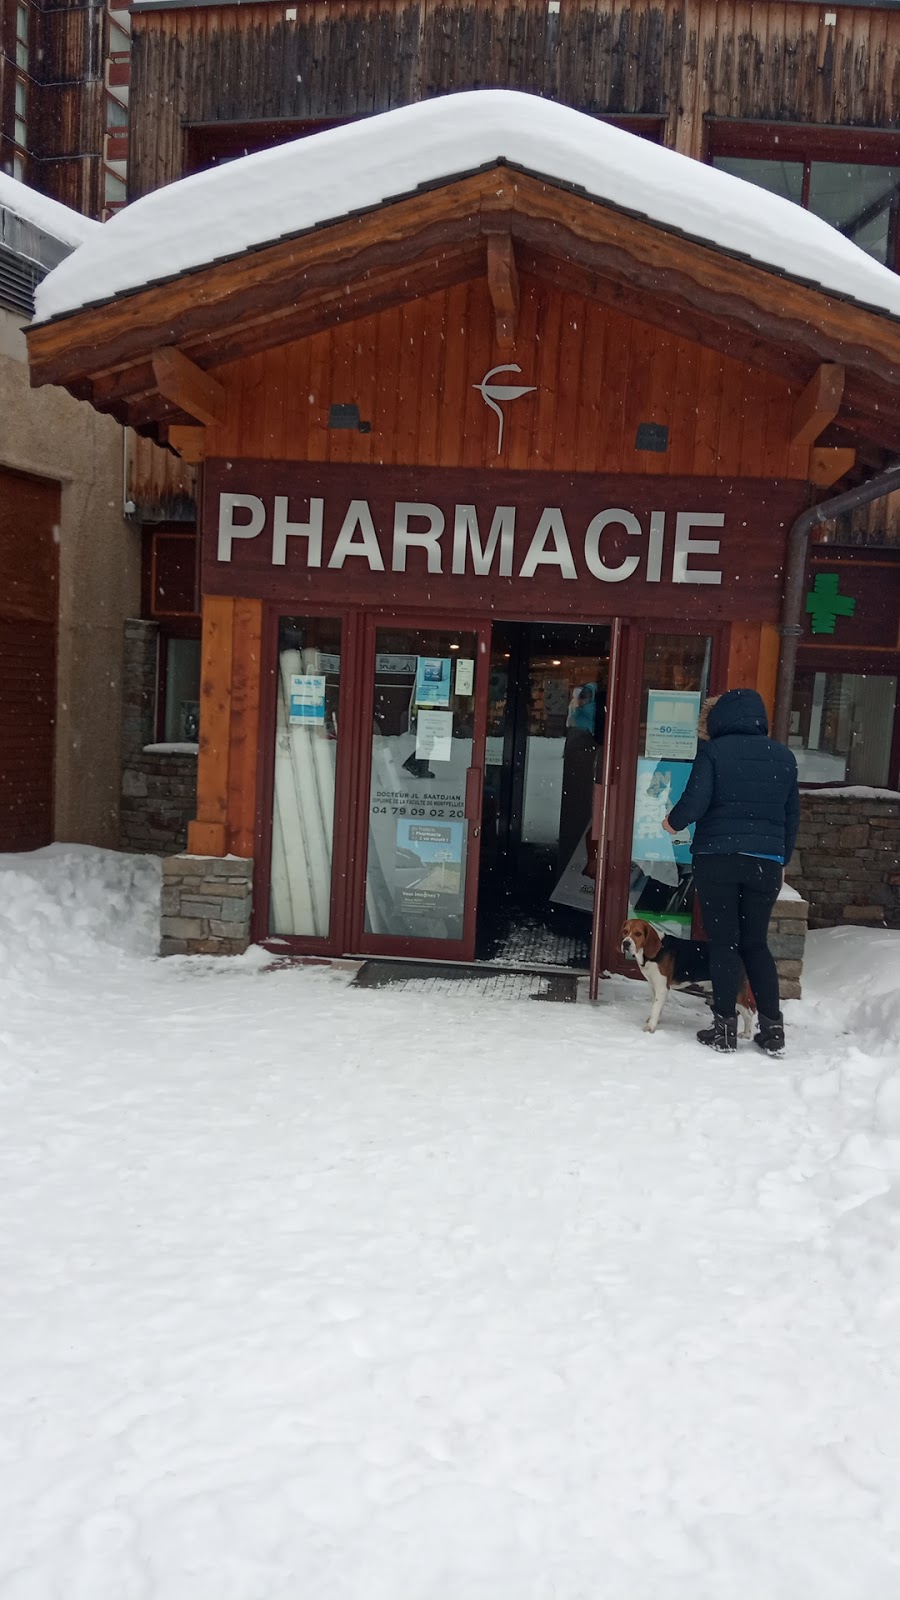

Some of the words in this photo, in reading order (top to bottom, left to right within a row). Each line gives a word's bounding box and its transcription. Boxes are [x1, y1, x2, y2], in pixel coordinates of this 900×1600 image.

[217, 492, 725, 584] PHARMACIE
[423, 793, 461, 801] SAATDJIAN
[372, 806, 387, 814] 04
[391, 807, 406, 815] 79
[410, 808, 426, 816] 09
[429, 809, 445, 817] 02
[449, 810, 464, 818] 20
